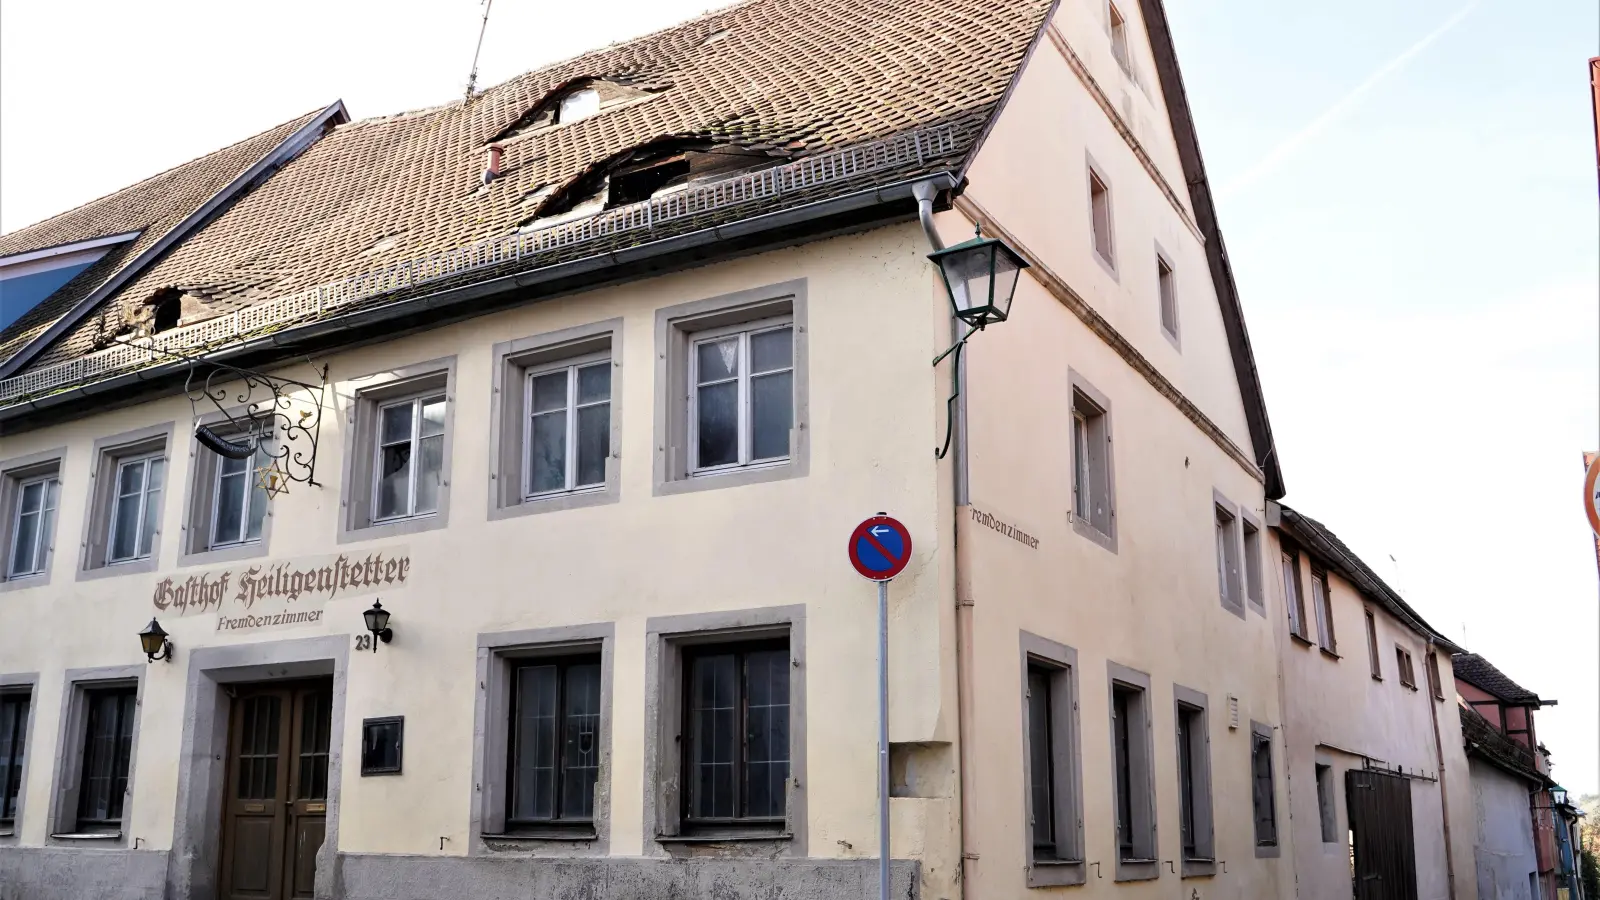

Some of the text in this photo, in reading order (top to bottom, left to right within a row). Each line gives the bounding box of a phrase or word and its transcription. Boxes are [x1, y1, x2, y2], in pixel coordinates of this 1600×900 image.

[968, 502, 1040, 550] remdenzimmer
[153, 553, 410, 616] Gasthof Heiligenstetter
[217, 609, 323, 631] Fremdenzimmer
[355, 634, 371, 651] 23
